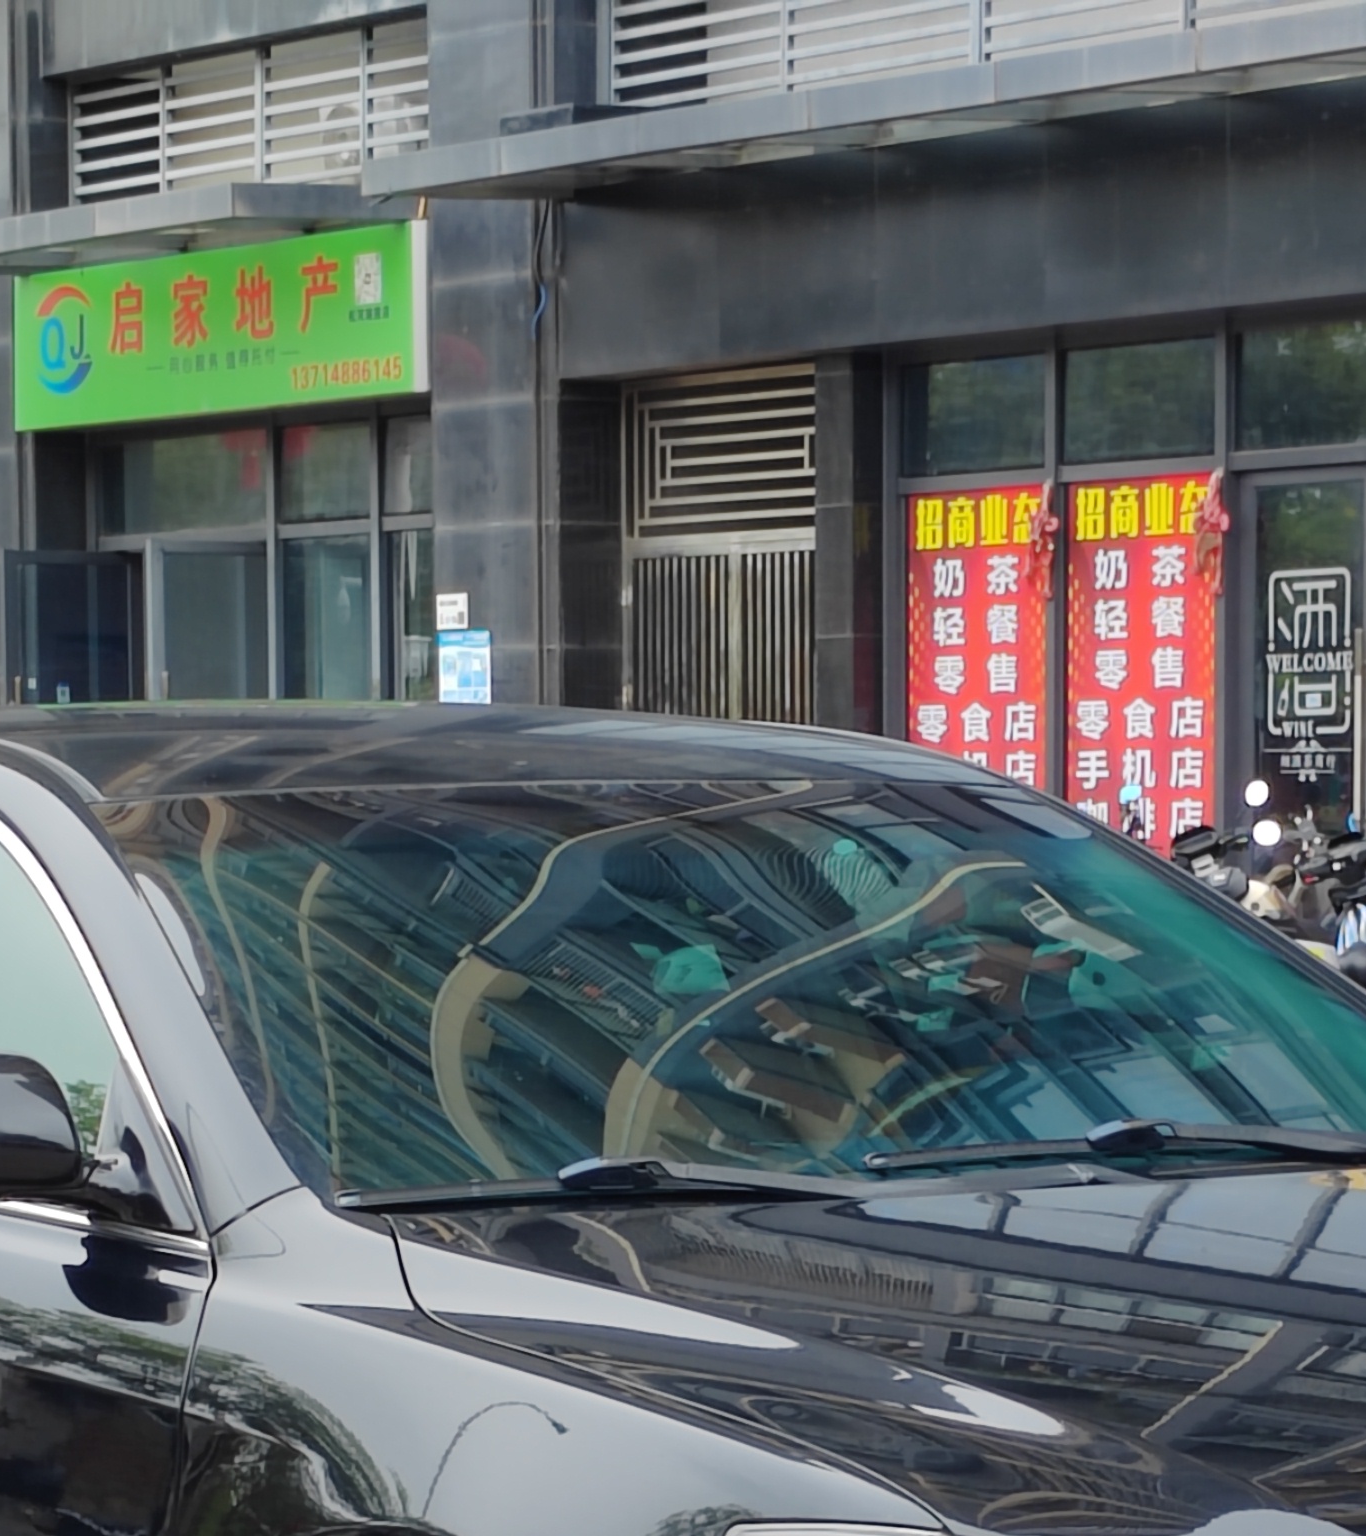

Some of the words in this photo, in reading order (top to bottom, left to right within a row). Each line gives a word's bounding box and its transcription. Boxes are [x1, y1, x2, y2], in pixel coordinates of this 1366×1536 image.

[109, 254, 340, 355] 启家地产
[291, 355, 403, 391] 13714886145
[933, 552, 1020, 598] 奶茶
[1094, 544, 1186, 590] 奶茶
[933, 604, 1020, 647] 轻餐
[1093, 596, 1186, 640] 轻餐
[933, 652, 1019, 695] 零售
[1094, 646, 1185, 690] 零售
[1265, 650, 1354, 674] WELCOME
[916, 701, 1037, 744] 零食店
[1076, 697, 1204, 741] 零食店
[1281, 719, 1315, 739] WINE
[1075, 747, 1204, 790] 手机店
